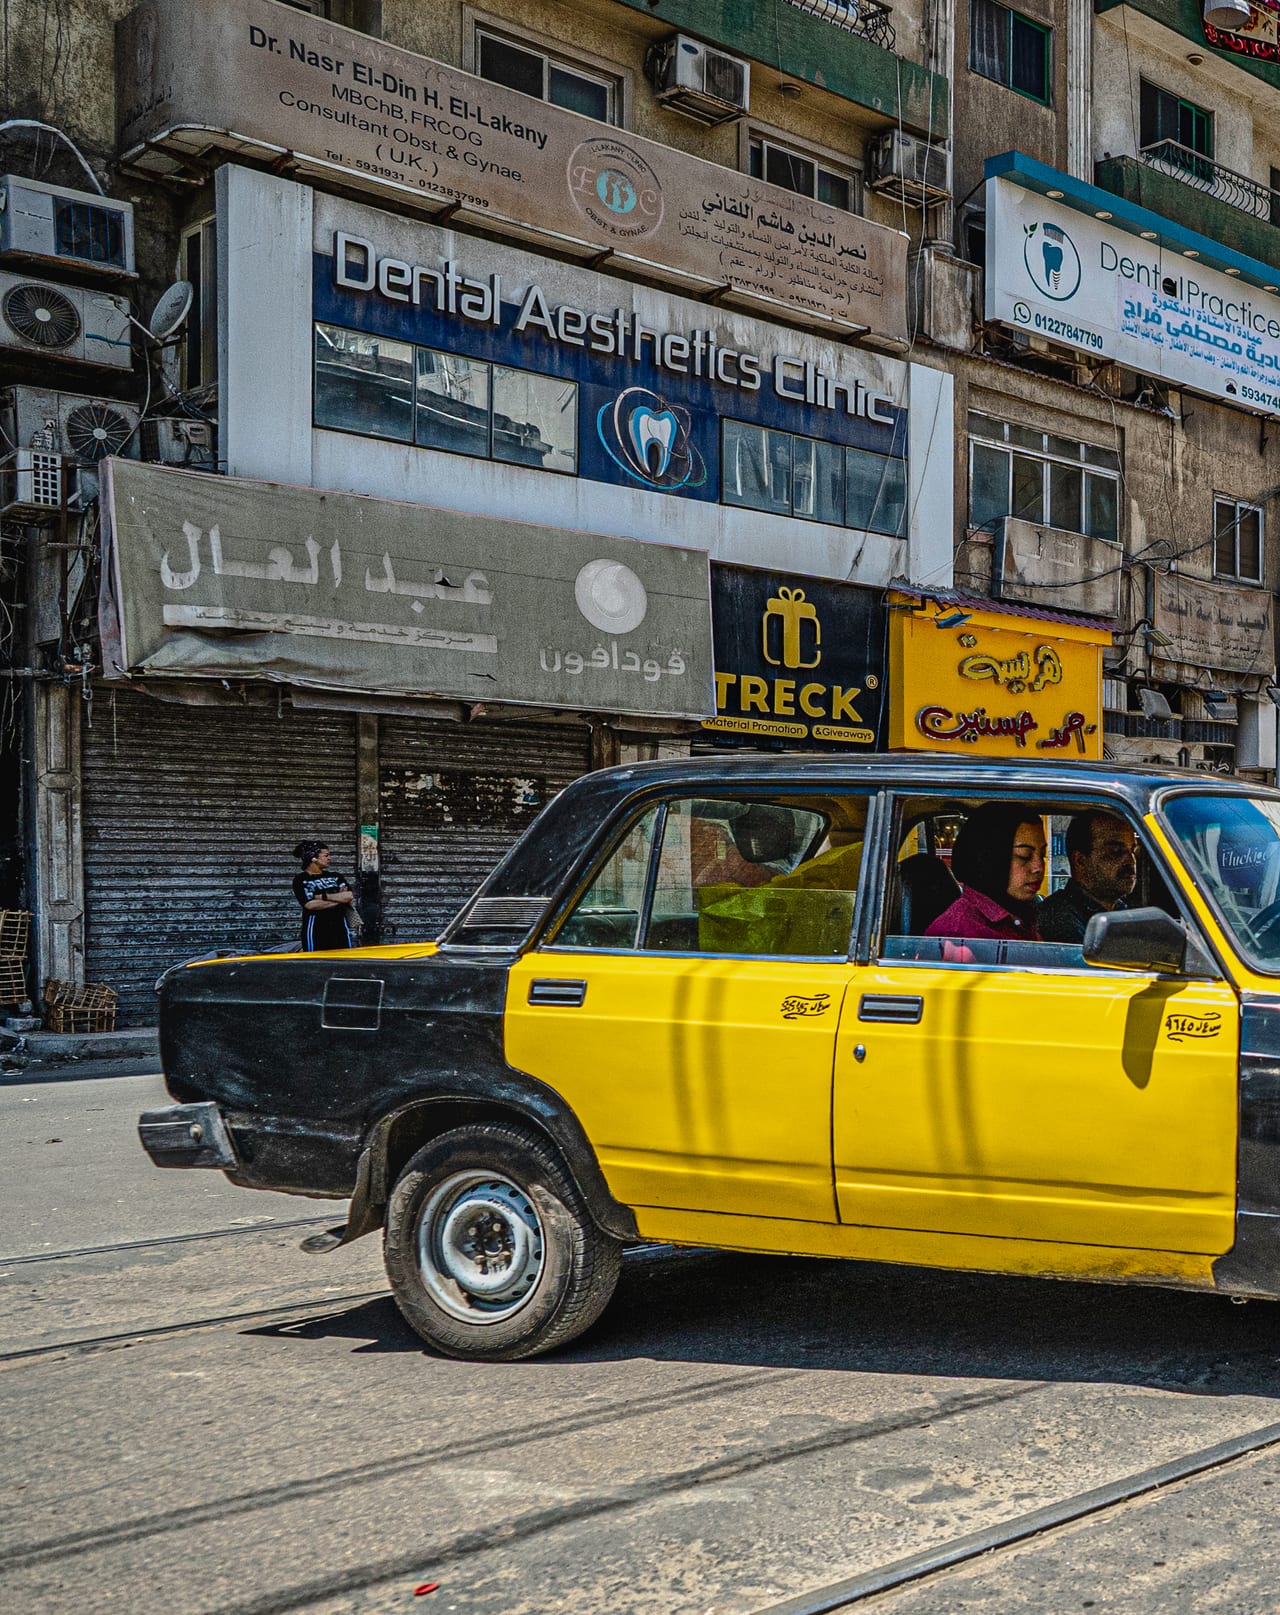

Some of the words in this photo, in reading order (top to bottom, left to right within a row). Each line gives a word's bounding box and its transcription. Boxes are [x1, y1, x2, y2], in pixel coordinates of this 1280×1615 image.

[250, 25, 281, 54] Dr.
[289, 39, 344, 75] Nasr
[353, 61, 416, 101] El-Din
[424, 87, 443, 110] H.
[450, 97, 548, 150] El-Lakany
[279, 91, 388, 138] Consultant
[393, 128, 442, 155] Obst.
[446, 145, 459, 161] &
[464, 152, 525, 184] Gynae.
[411, 110, 482, 146] FRCOG
[324, 149, 342, 162] Tel
[356, 159, 404, 182] 5931931
[419, 179, 489, 208] 0123837999
[702, 193, 753, 220] اللقاني
[757, 211, 795, 234] هاشم
[798, 224, 835, 249] الدين
[836, 244, 867, 260] نصر
[1123, 300, 1163, 326] فراج
[1152, 292, 1195, 319] الدكتورة
[334, 230, 500, 325] Dental
[514, 285, 761, 390] Aesthetics
[773, 355, 894, 425] Clinic
[1035, 313, 1103, 349] 01227847790
[1166, 320, 1242, 355] مصطفى
[1236, 326, 1263, 345] عيادة
[160, 520, 341, 591] العال
[365, 551, 493, 614] عبد
[349, 622, 409, 637] خدمة
[413, 627, 473, 644] مركز
[715, 672, 863, 723] TRECK
[752, 721, 803, 735] Promotion
